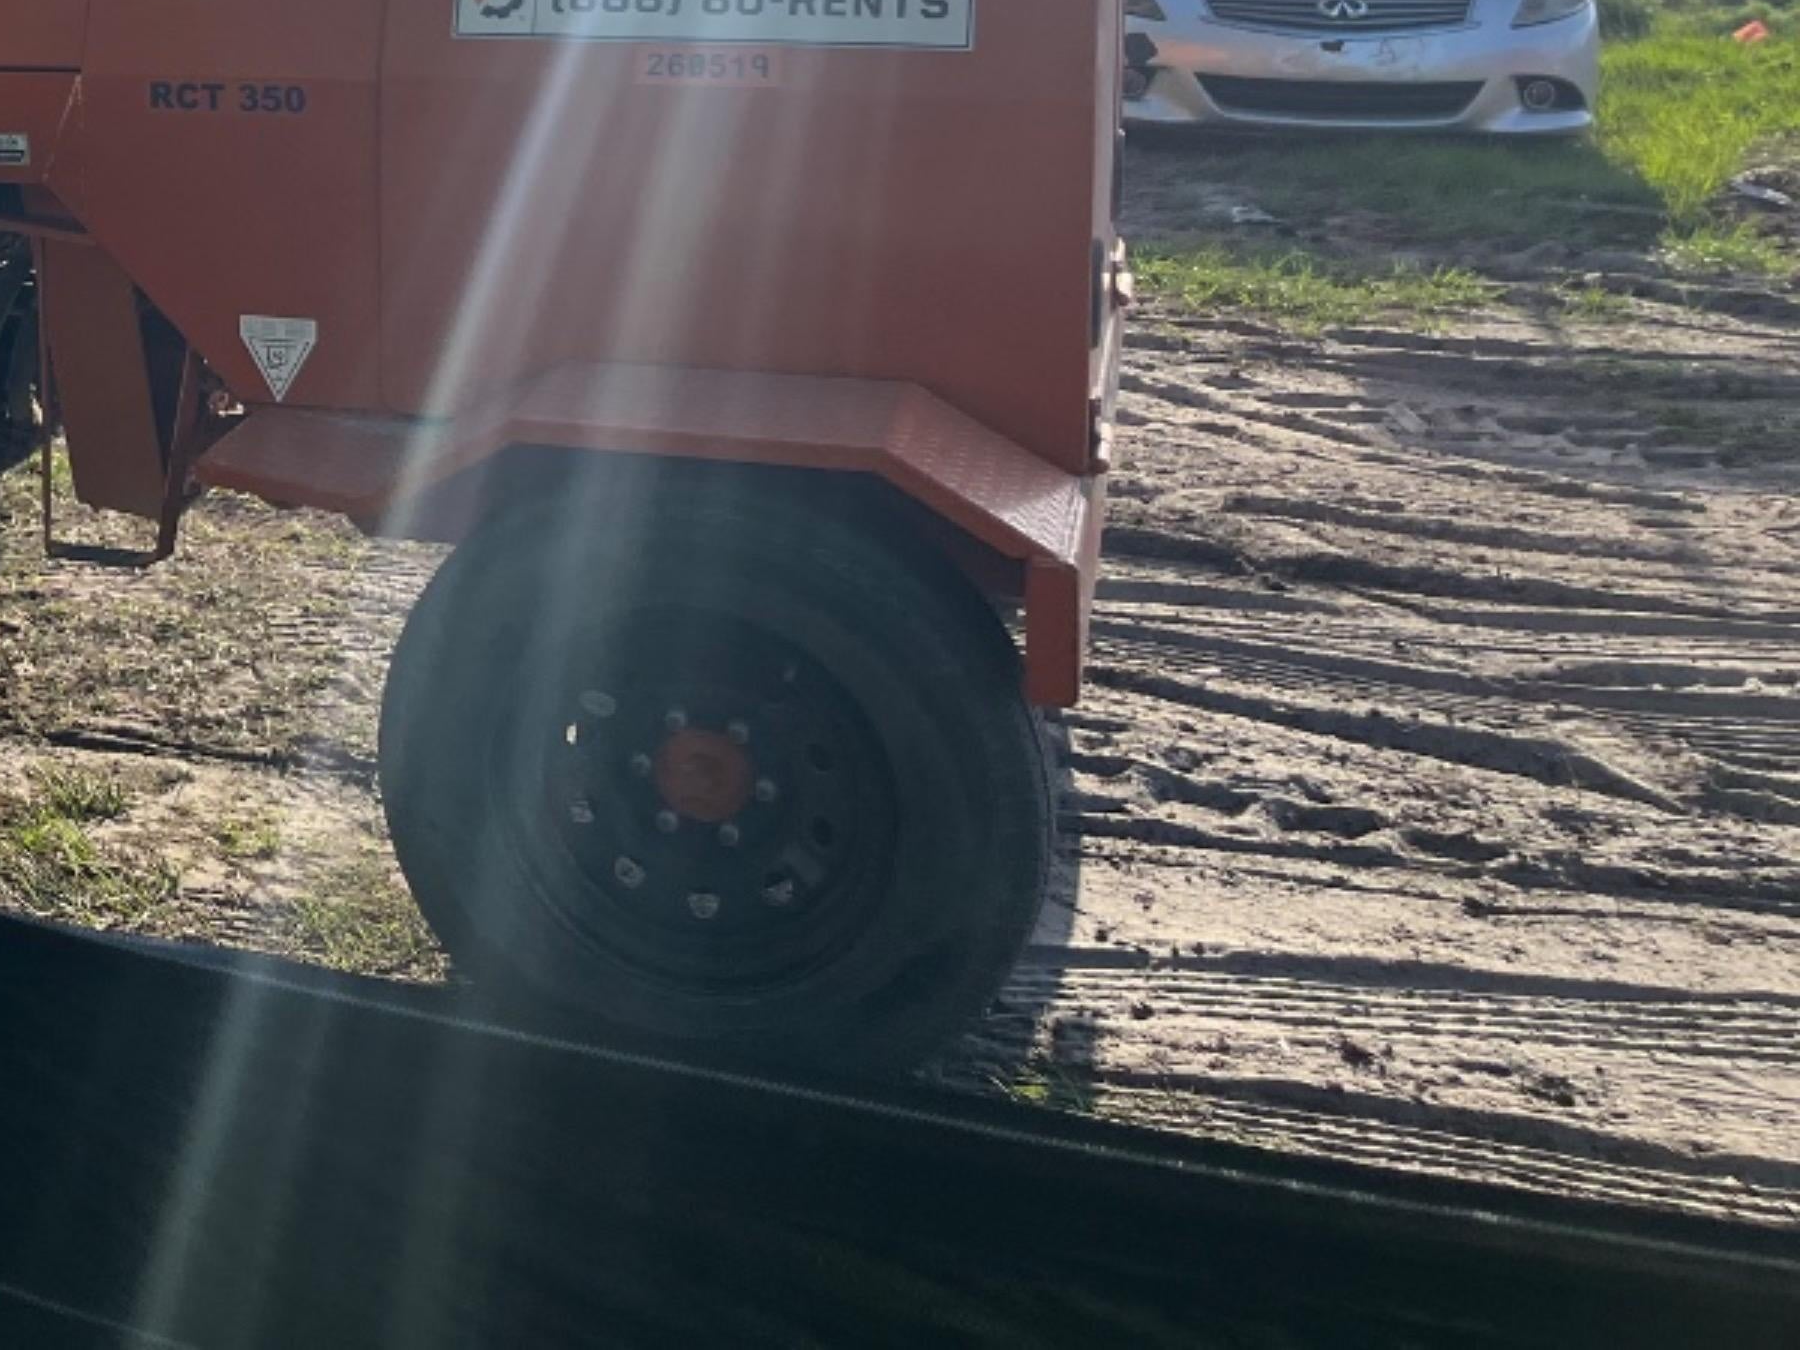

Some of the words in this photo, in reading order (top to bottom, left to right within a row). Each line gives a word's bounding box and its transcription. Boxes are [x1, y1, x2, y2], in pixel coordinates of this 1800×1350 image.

[646, 52, 770, 79] 260519
[149, 81, 226, 111] RCT
[238, 82, 307, 114] 350
